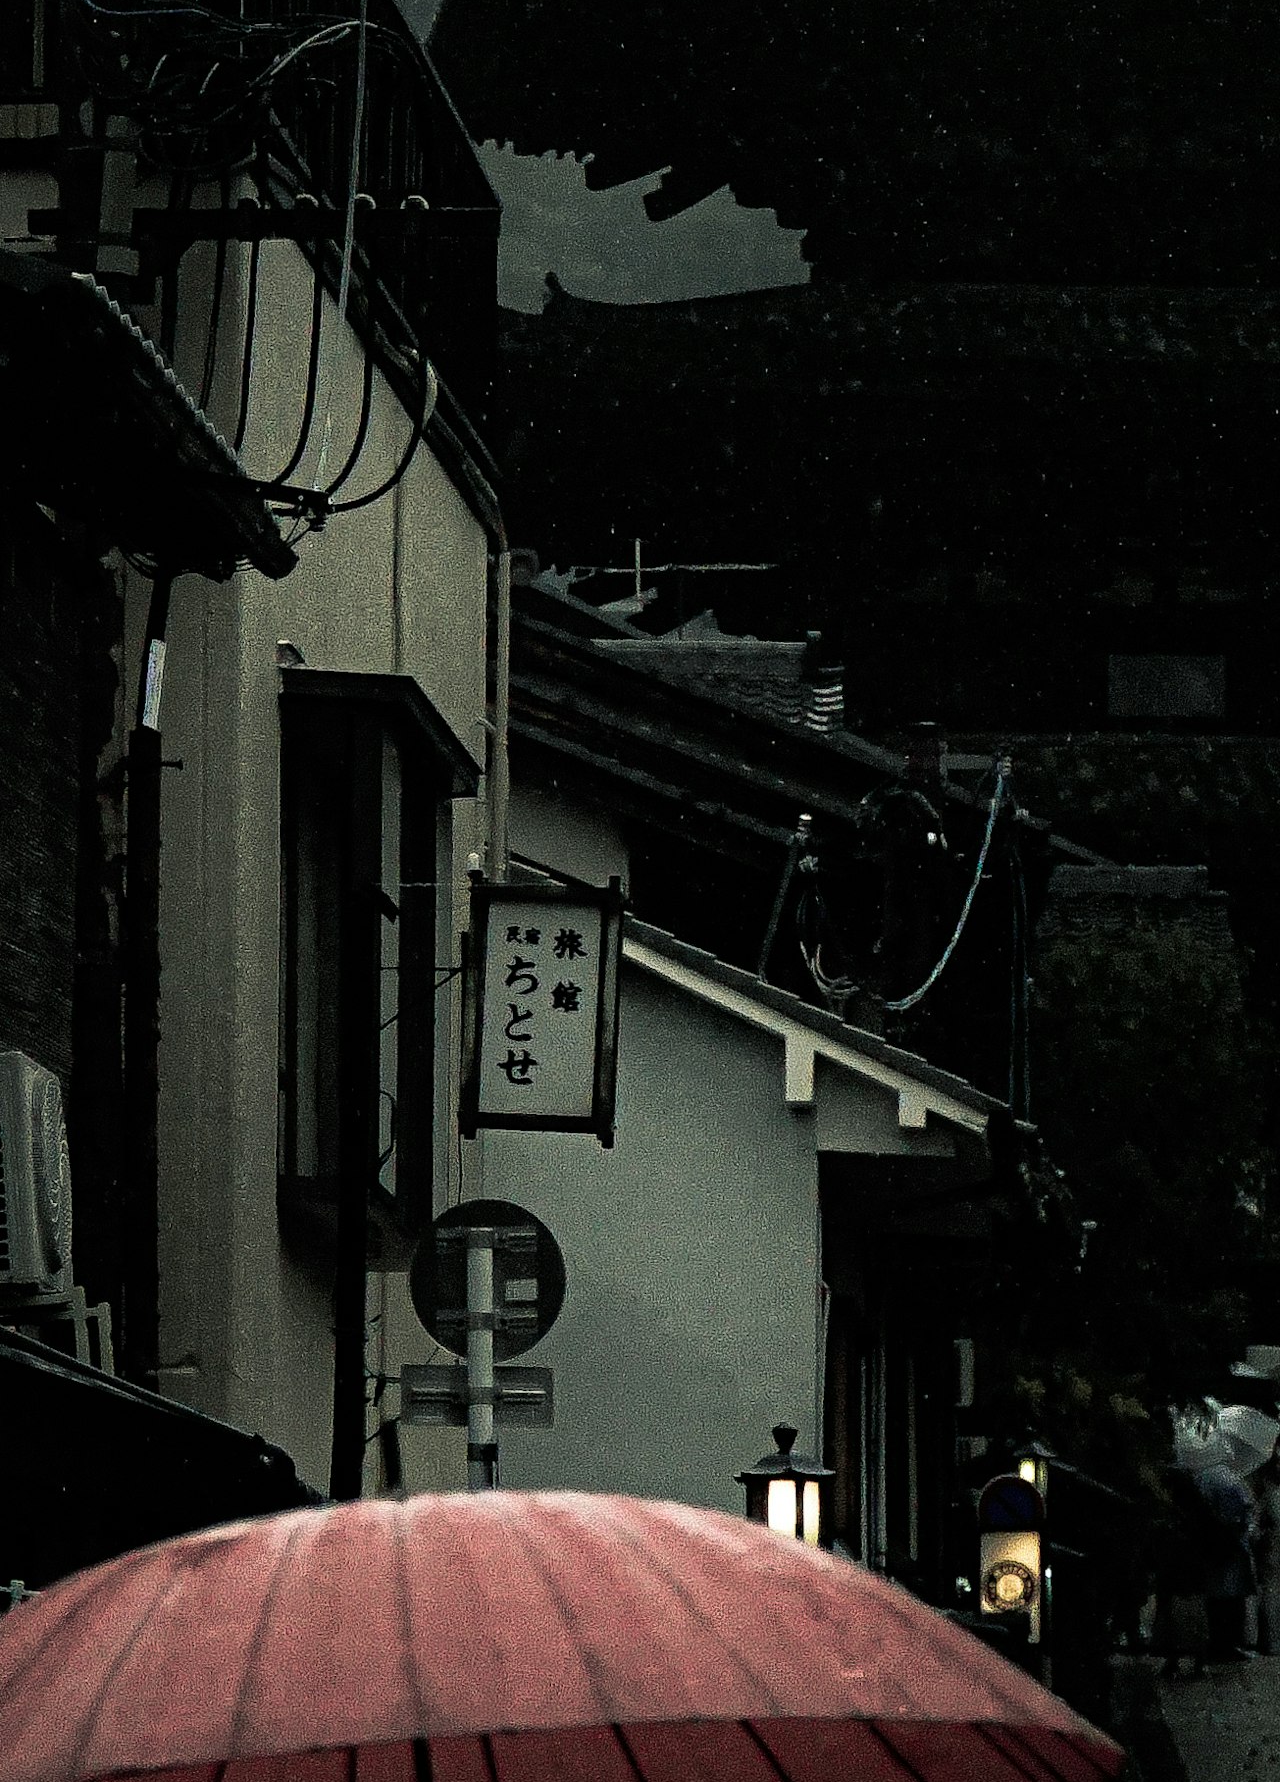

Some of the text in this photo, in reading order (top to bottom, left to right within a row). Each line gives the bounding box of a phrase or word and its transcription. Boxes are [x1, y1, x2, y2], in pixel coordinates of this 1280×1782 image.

[497, 955, 539, 1086] ちとせ
[551, 928, 587, 1012] 旅館
